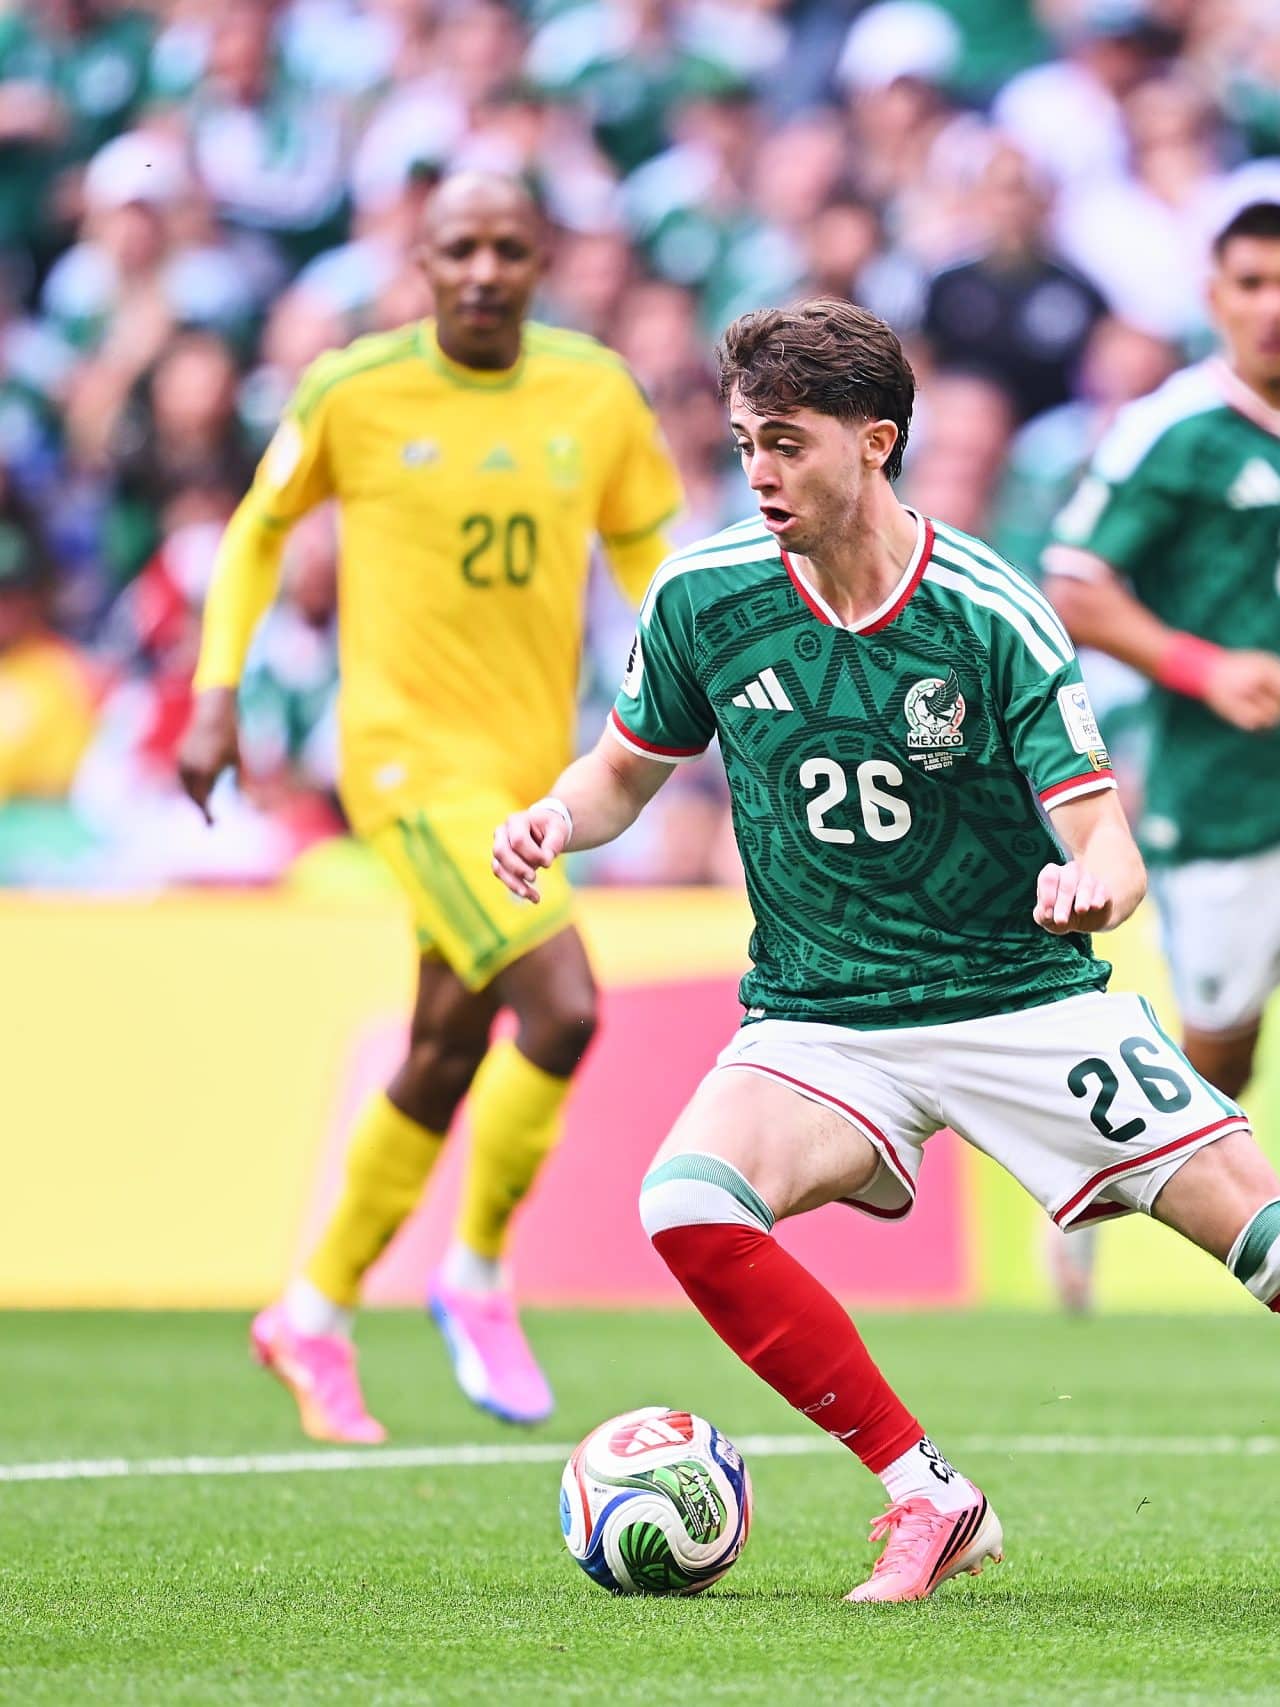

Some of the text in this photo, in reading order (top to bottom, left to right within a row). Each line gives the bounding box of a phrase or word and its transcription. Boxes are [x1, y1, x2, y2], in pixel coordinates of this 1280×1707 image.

[460, 513, 538, 589] 20
[799, 757, 912, 845] 26
[1067, 1036, 1192, 1143] 26
